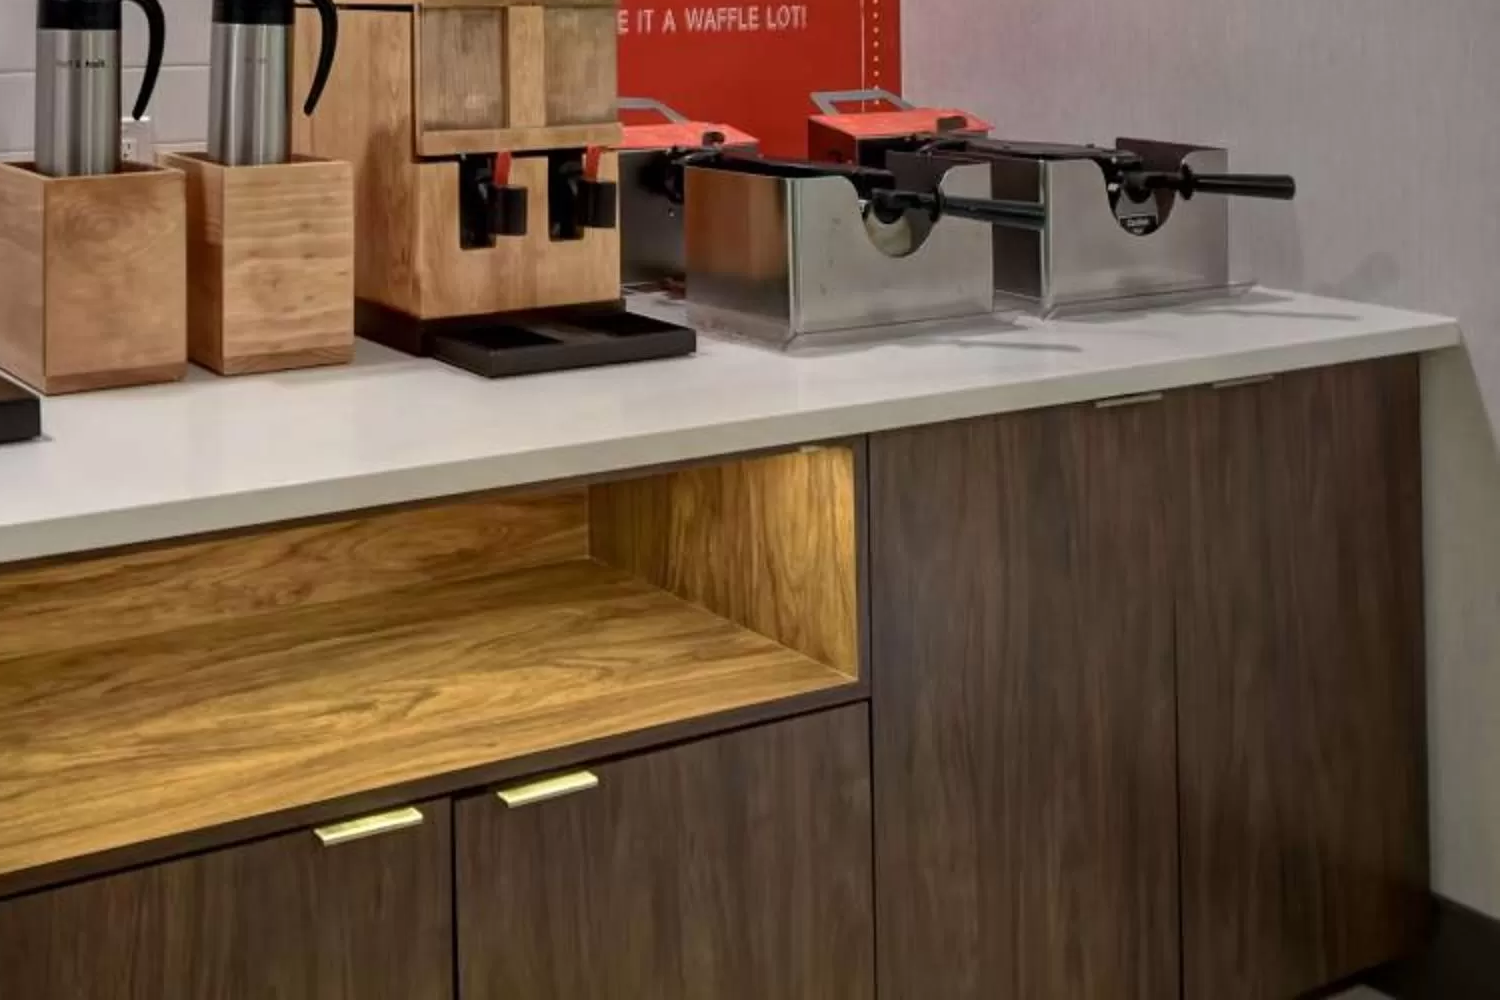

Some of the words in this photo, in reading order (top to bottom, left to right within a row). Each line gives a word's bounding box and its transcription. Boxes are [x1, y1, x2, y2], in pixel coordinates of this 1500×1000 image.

[637, 9, 656, 34] IT
[662, 8, 678, 34] A
[684, 5, 760, 34] WAFFLE
[765, 4, 808, 31] LOT!
